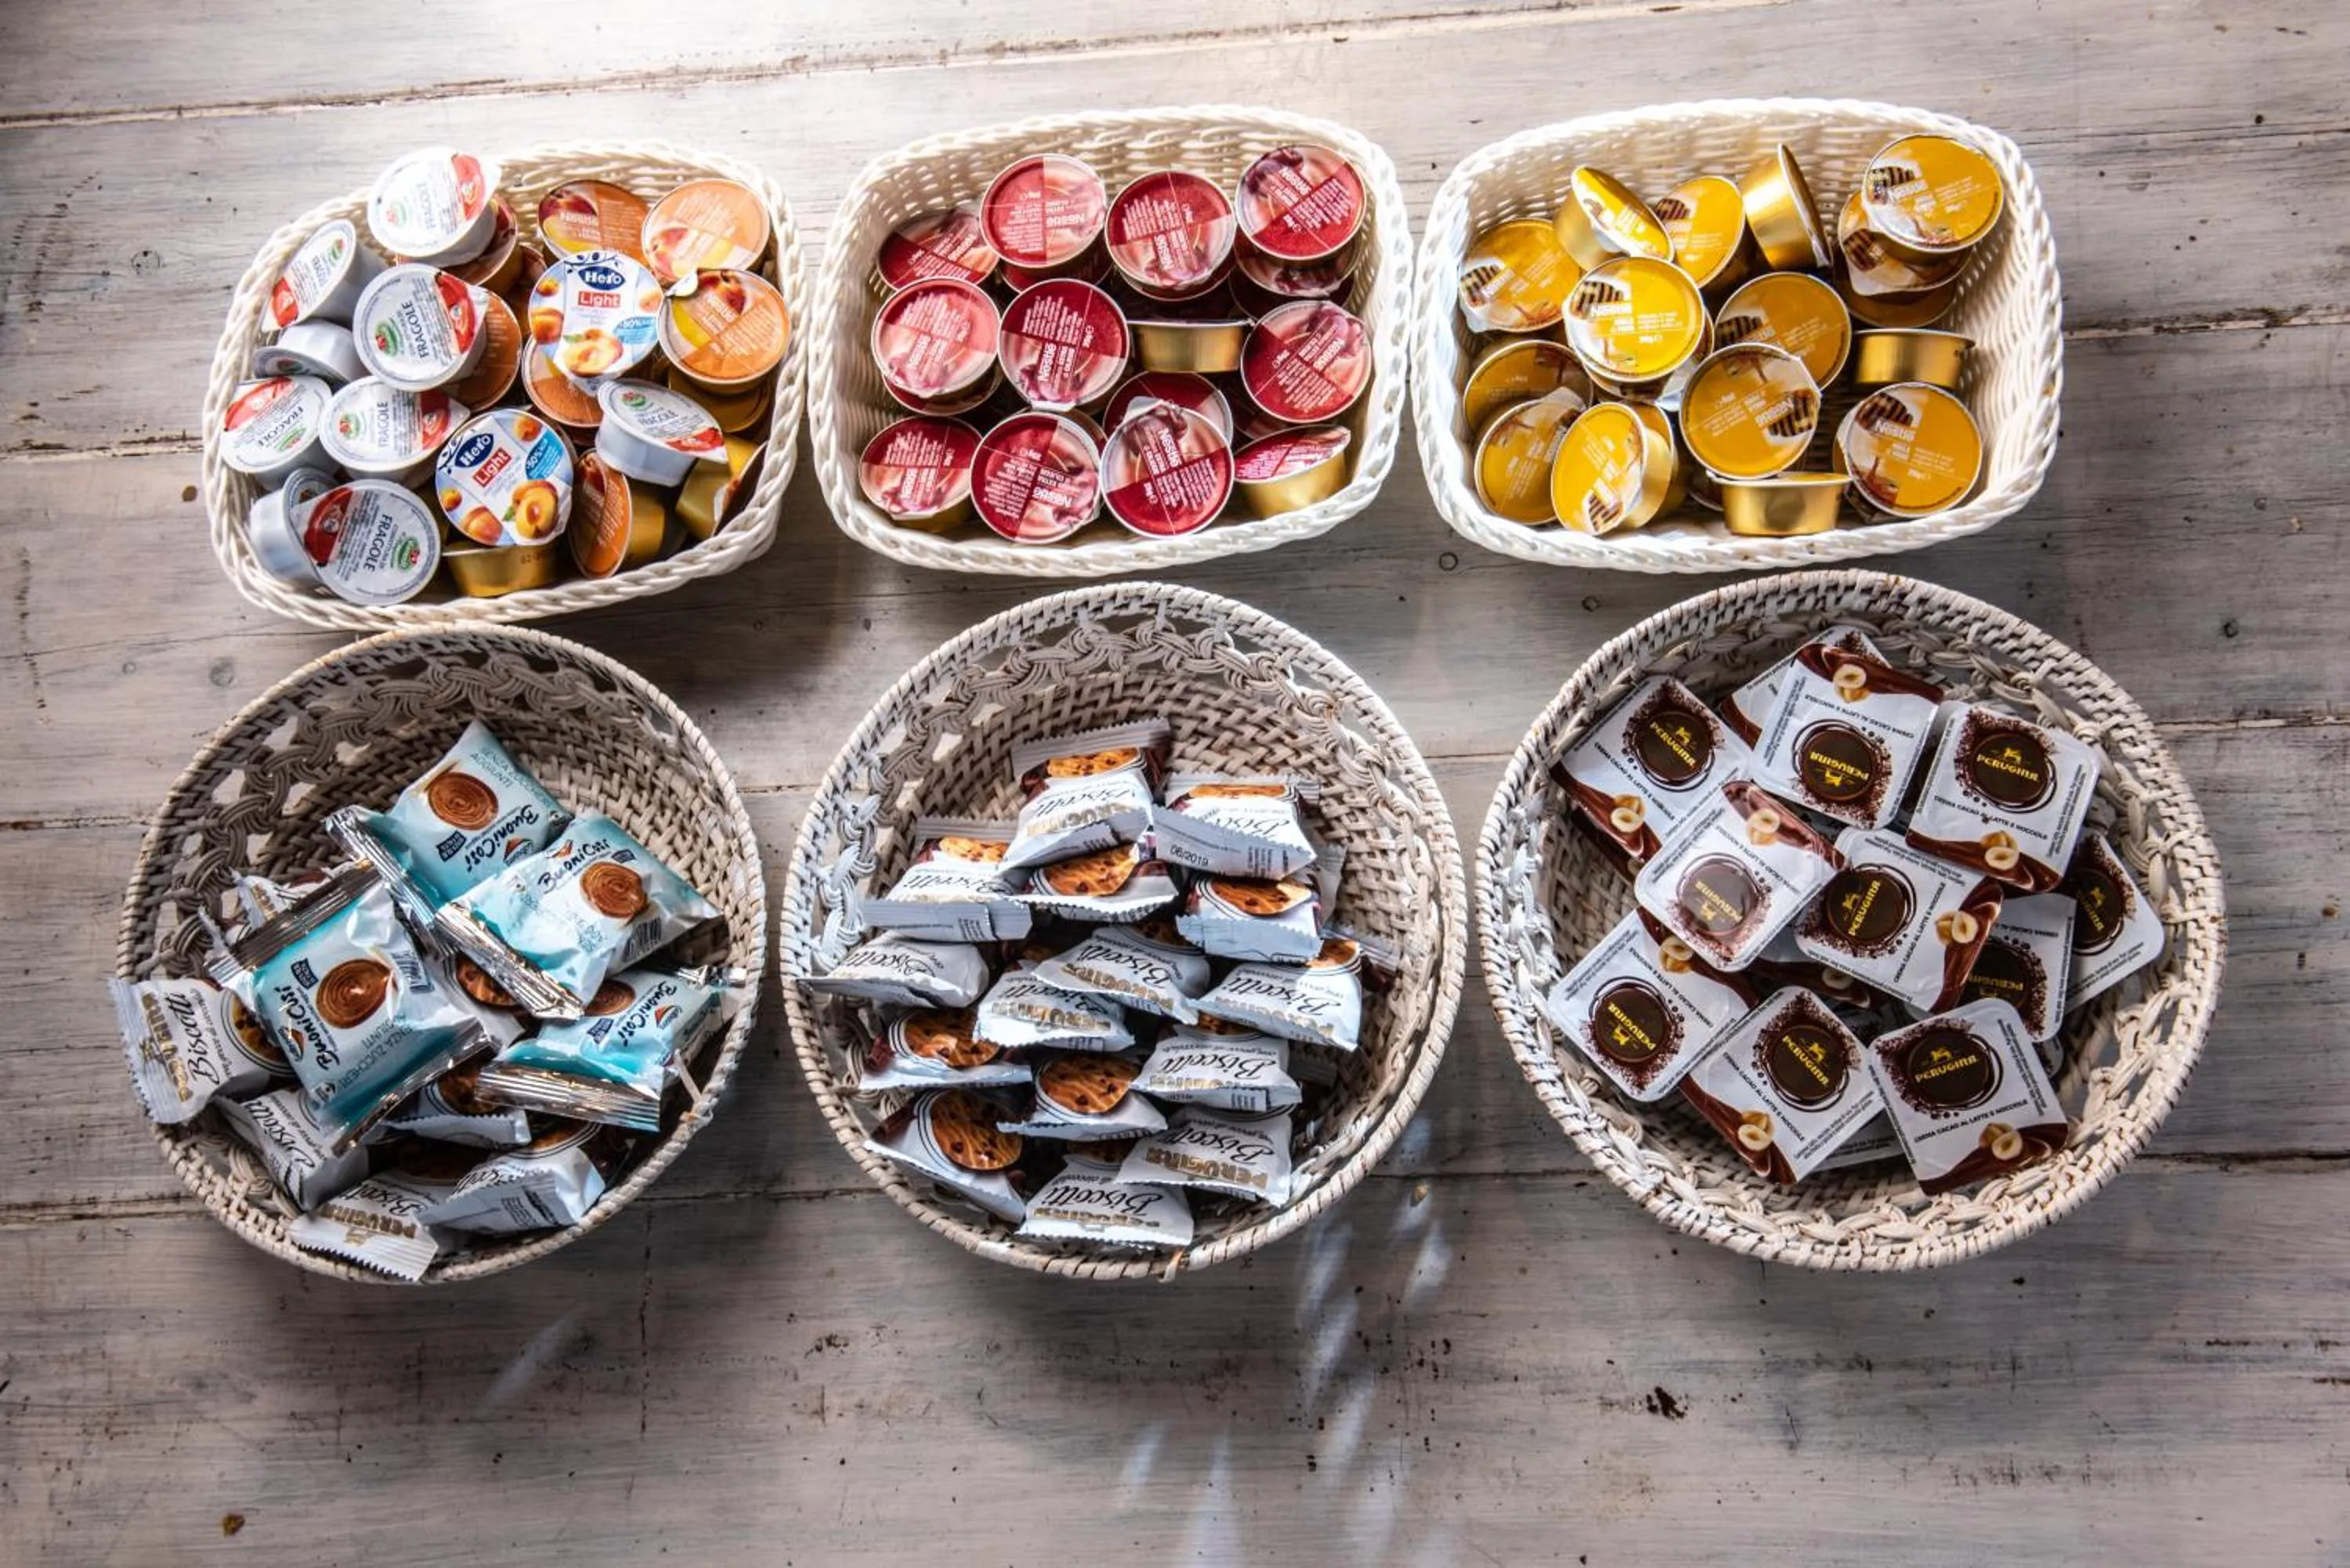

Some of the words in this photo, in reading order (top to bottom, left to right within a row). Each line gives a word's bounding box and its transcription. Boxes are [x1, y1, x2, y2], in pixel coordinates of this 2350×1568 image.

[585, 270, 622, 285] Hero
[580, 292, 620, 308] Light
[401, 300, 429, 359] FRAGOLE
[258, 405, 304, 449] FRAGOLE
[377, 401, 389, 447] FRAGOLE
[459, 434, 491, 467] Hero
[475, 450, 510, 485] Light
[363, 513, 392, 572] FRAGOLE
[1649, 721, 1697, 770] PERUGINA
[1810, 752, 1869, 780] PERUGINA
[1976, 754, 2039, 782] PERUGINA
[1170, 844, 1209, 866] 06/2019
[1695, 880, 1743, 923] PERUGINA
[1849, 880, 1880, 937] PERUGINA
[1078, 943, 1171, 988] Biscotti
[1967, 974, 2023, 992] PERUGIN
[999, 984, 1109, 1015] Biscotti
[1222, 976, 1342, 1017] Biscotti
[164, 992, 220, 1085] Biscotti
[1607, 1002, 1656, 1051] PERUGINA
[342, 1047, 384, 1089] ZUCCHERI
[1161, 1052, 1277, 1079] Biscotti
[1782, 1035, 1830, 1087] PERUGINA
[1914, 1054, 1978, 1083] PERUGINA
[1159, 1126, 1274, 1163] Biscotti
[1043, 1184, 1164, 1216] Biscotti
